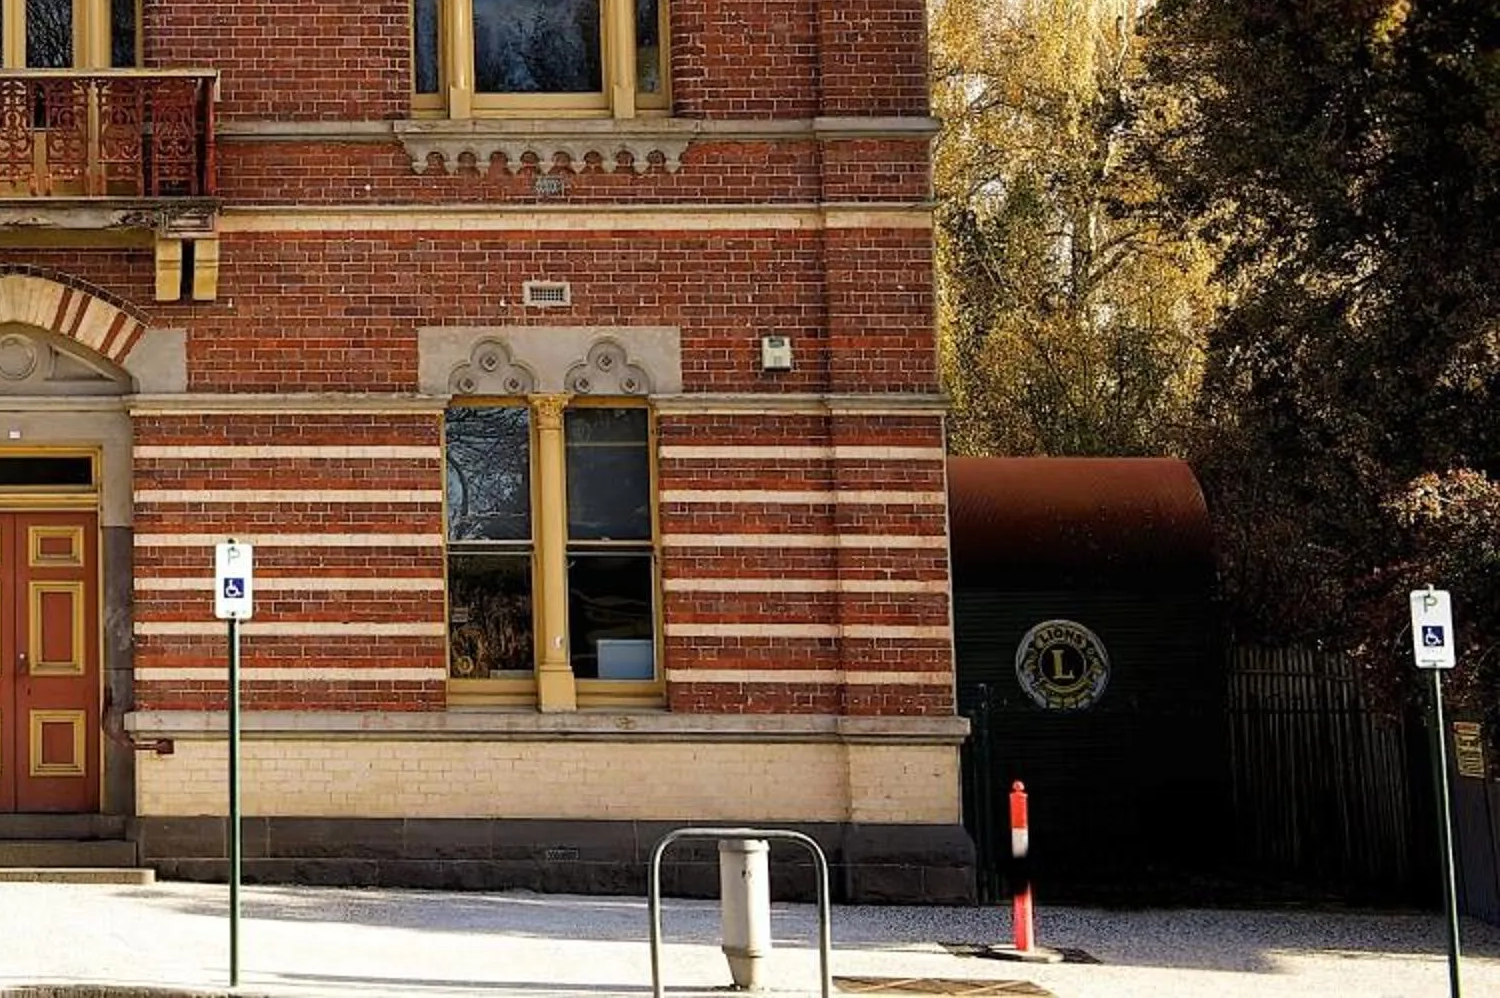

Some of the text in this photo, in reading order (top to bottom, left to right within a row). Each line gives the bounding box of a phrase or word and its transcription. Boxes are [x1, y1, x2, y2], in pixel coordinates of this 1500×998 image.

[227, 547, 241, 566] P
[1423, 595, 1438, 613] P
[1040, 628, 1085, 645] LIONS
[1051, 649, 1076, 679] L
